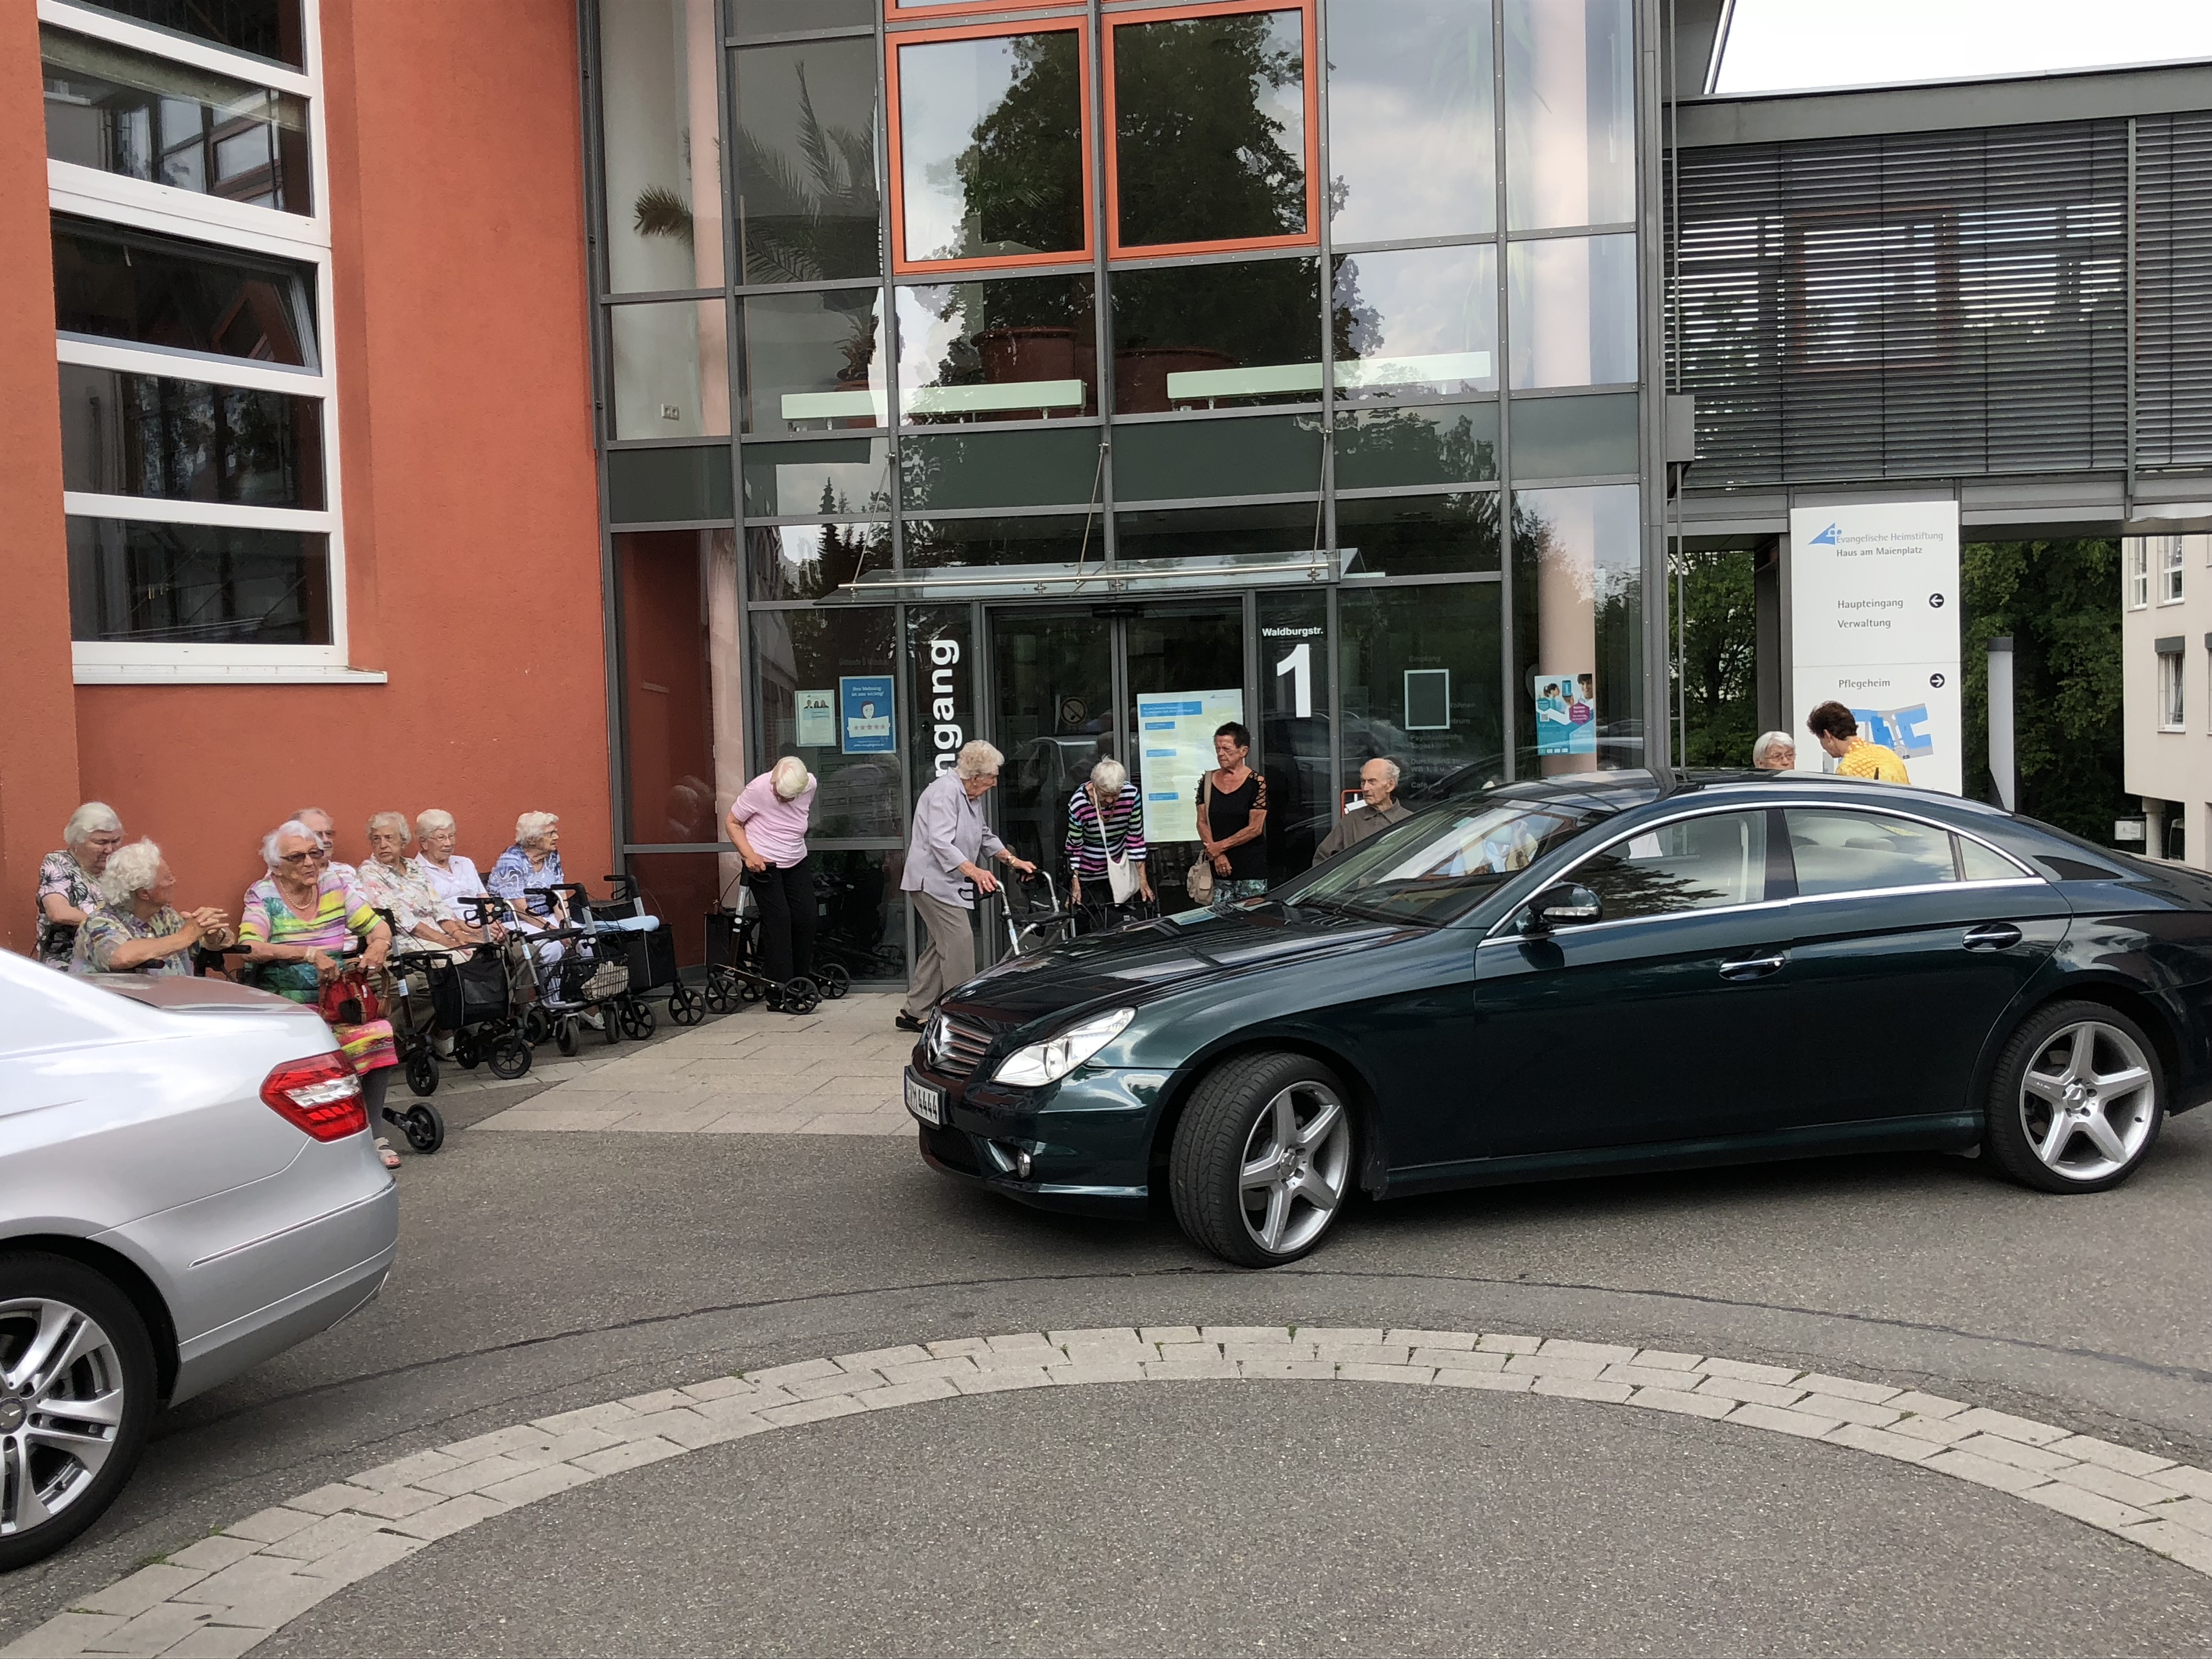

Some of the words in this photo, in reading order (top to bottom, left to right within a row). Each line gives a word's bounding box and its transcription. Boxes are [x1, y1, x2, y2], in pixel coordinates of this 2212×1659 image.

[1836, 533, 1888, 544] Evangelische
[1891, 532, 1944, 541] Heimstiftung
[1836, 549, 1858, 557] Haus
[1876, 546, 1923, 556] Maienplatz
[1837, 599, 1904, 610] Haupteingang
[1837, 619, 1891, 629] Verwaltung
[1262, 627, 1324, 637] Waldburgstr.
[1276, 644, 1312, 718] 1
[1838, 678, 1891, 690] Pflegeheim
[929, 639, 963, 786] ngang
